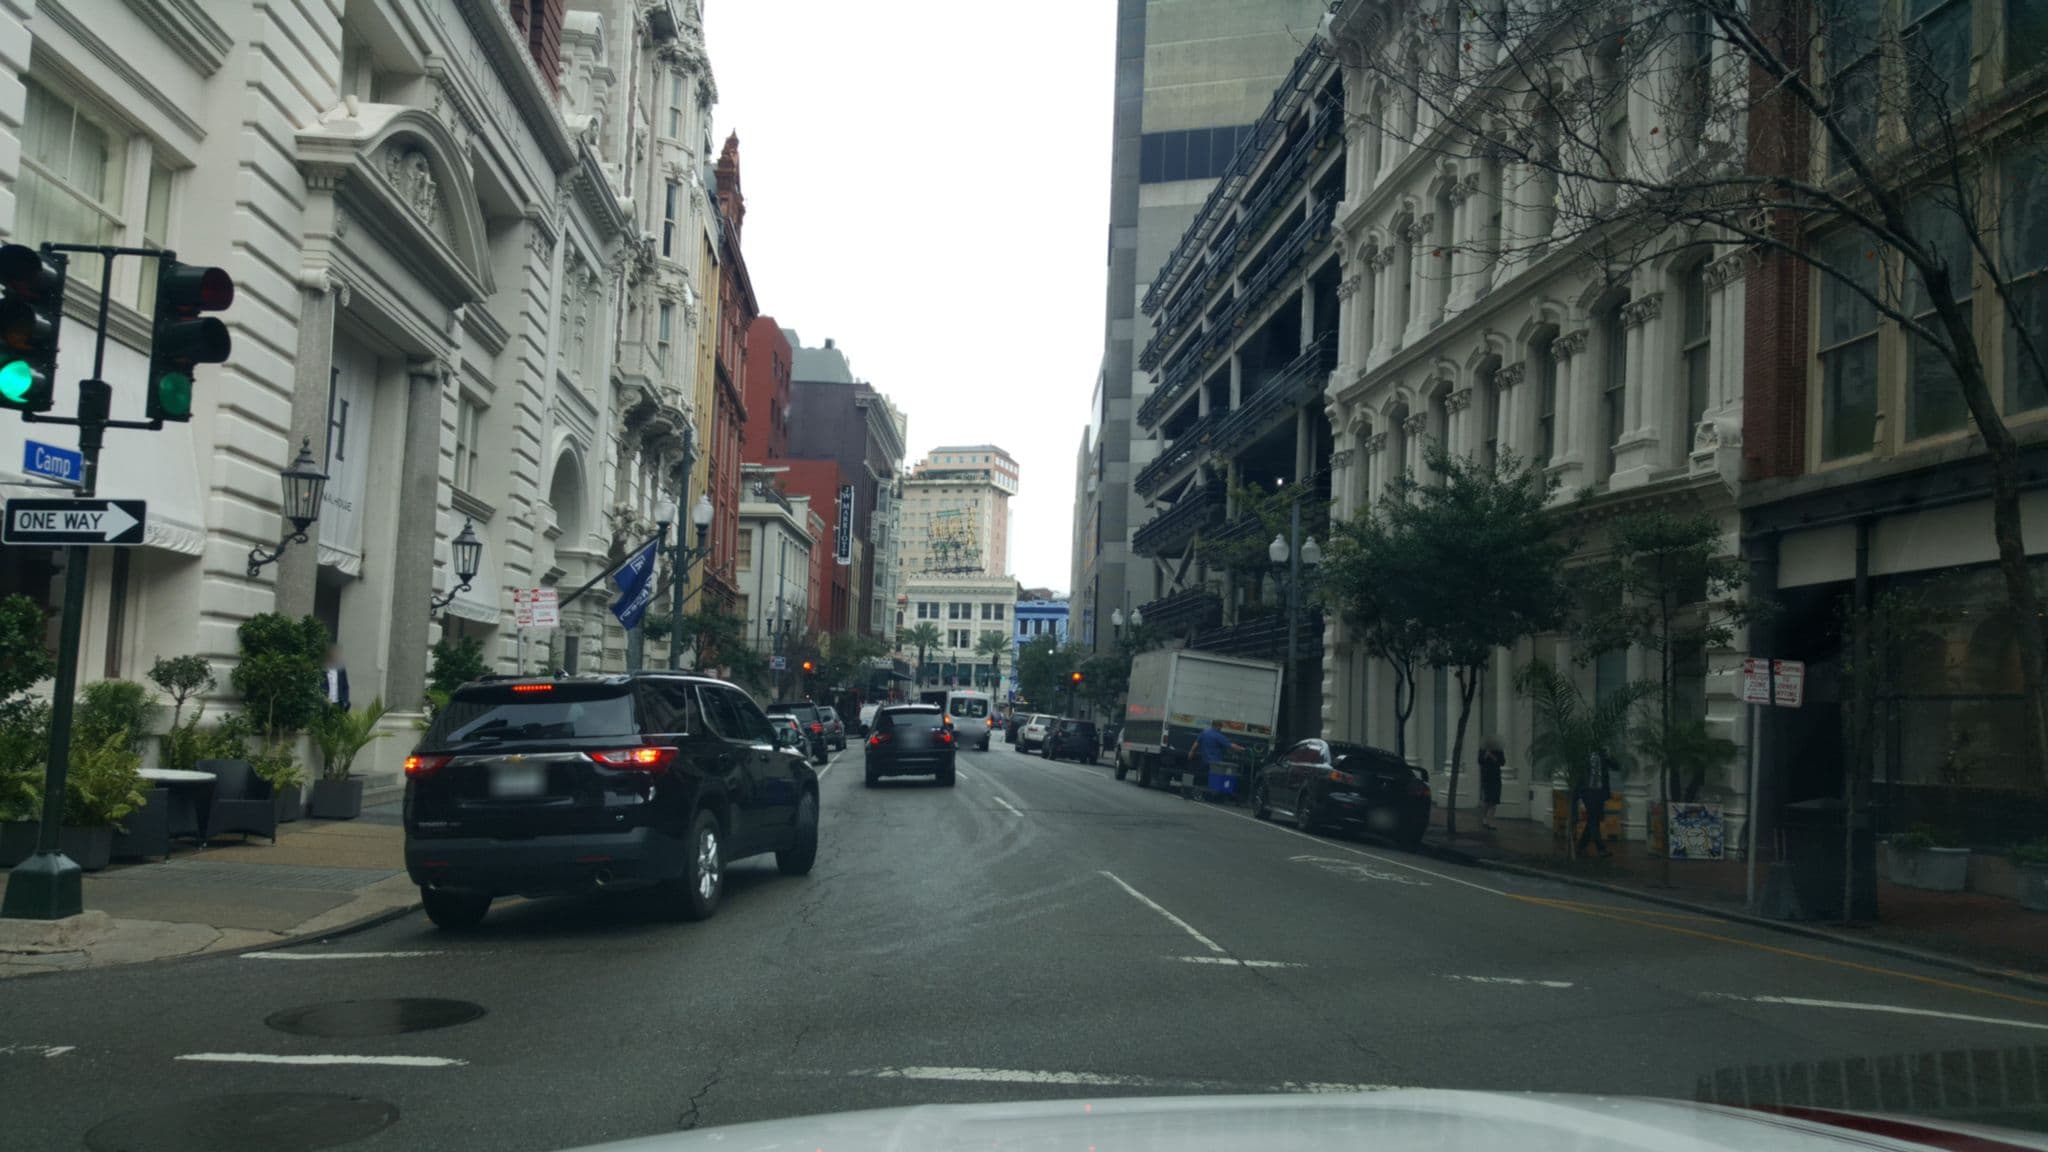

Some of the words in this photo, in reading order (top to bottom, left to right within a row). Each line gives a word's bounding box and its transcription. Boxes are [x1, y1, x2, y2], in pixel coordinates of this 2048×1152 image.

[35, 447, 71, 477] Camp
[19, 512, 56, 529] ONE
[64, 513, 104, 529] WAY
[841, 504, 850, 555] MARRIOTT
